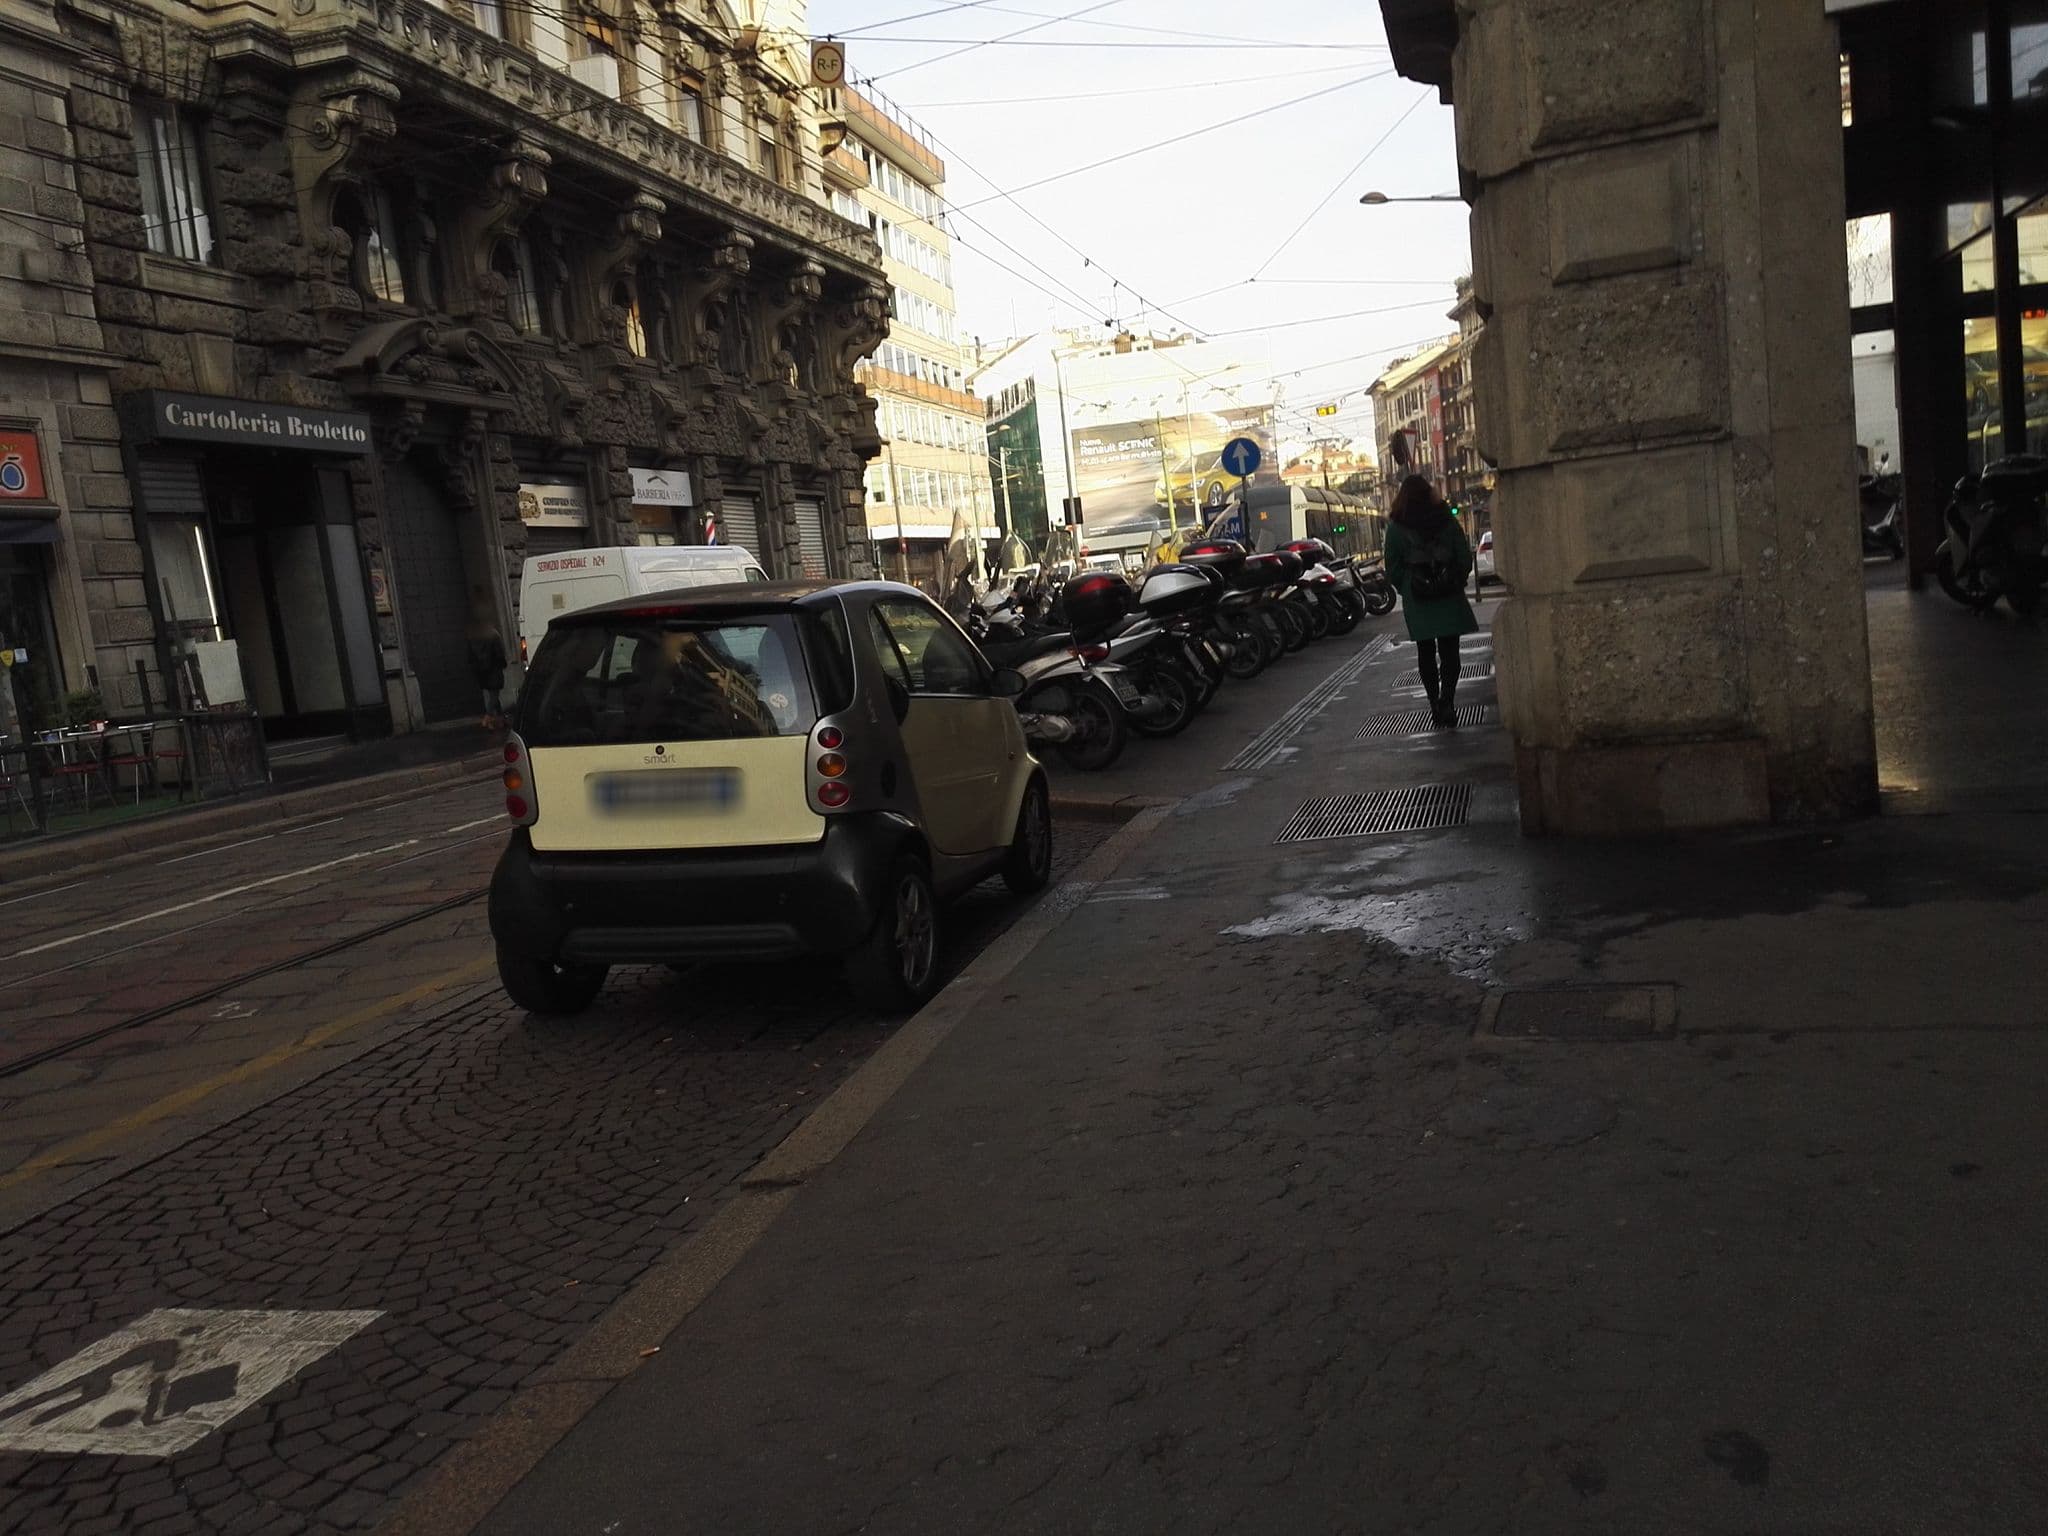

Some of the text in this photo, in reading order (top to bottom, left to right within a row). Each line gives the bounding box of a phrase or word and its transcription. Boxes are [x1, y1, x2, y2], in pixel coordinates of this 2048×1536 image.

[817, 58, 838, 71] R-F
[164, 402, 367, 443] Cartoleria Broletto
[1080, 442, 1116, 457] Renault
[1118, 437, 1155, 451] SCENIC
[637, 488, 671, 500] BARBERIA
[537, 555, 605, 572] SERVIZIO OSPEDALE h24
[643, 754, 676, 765] smart
